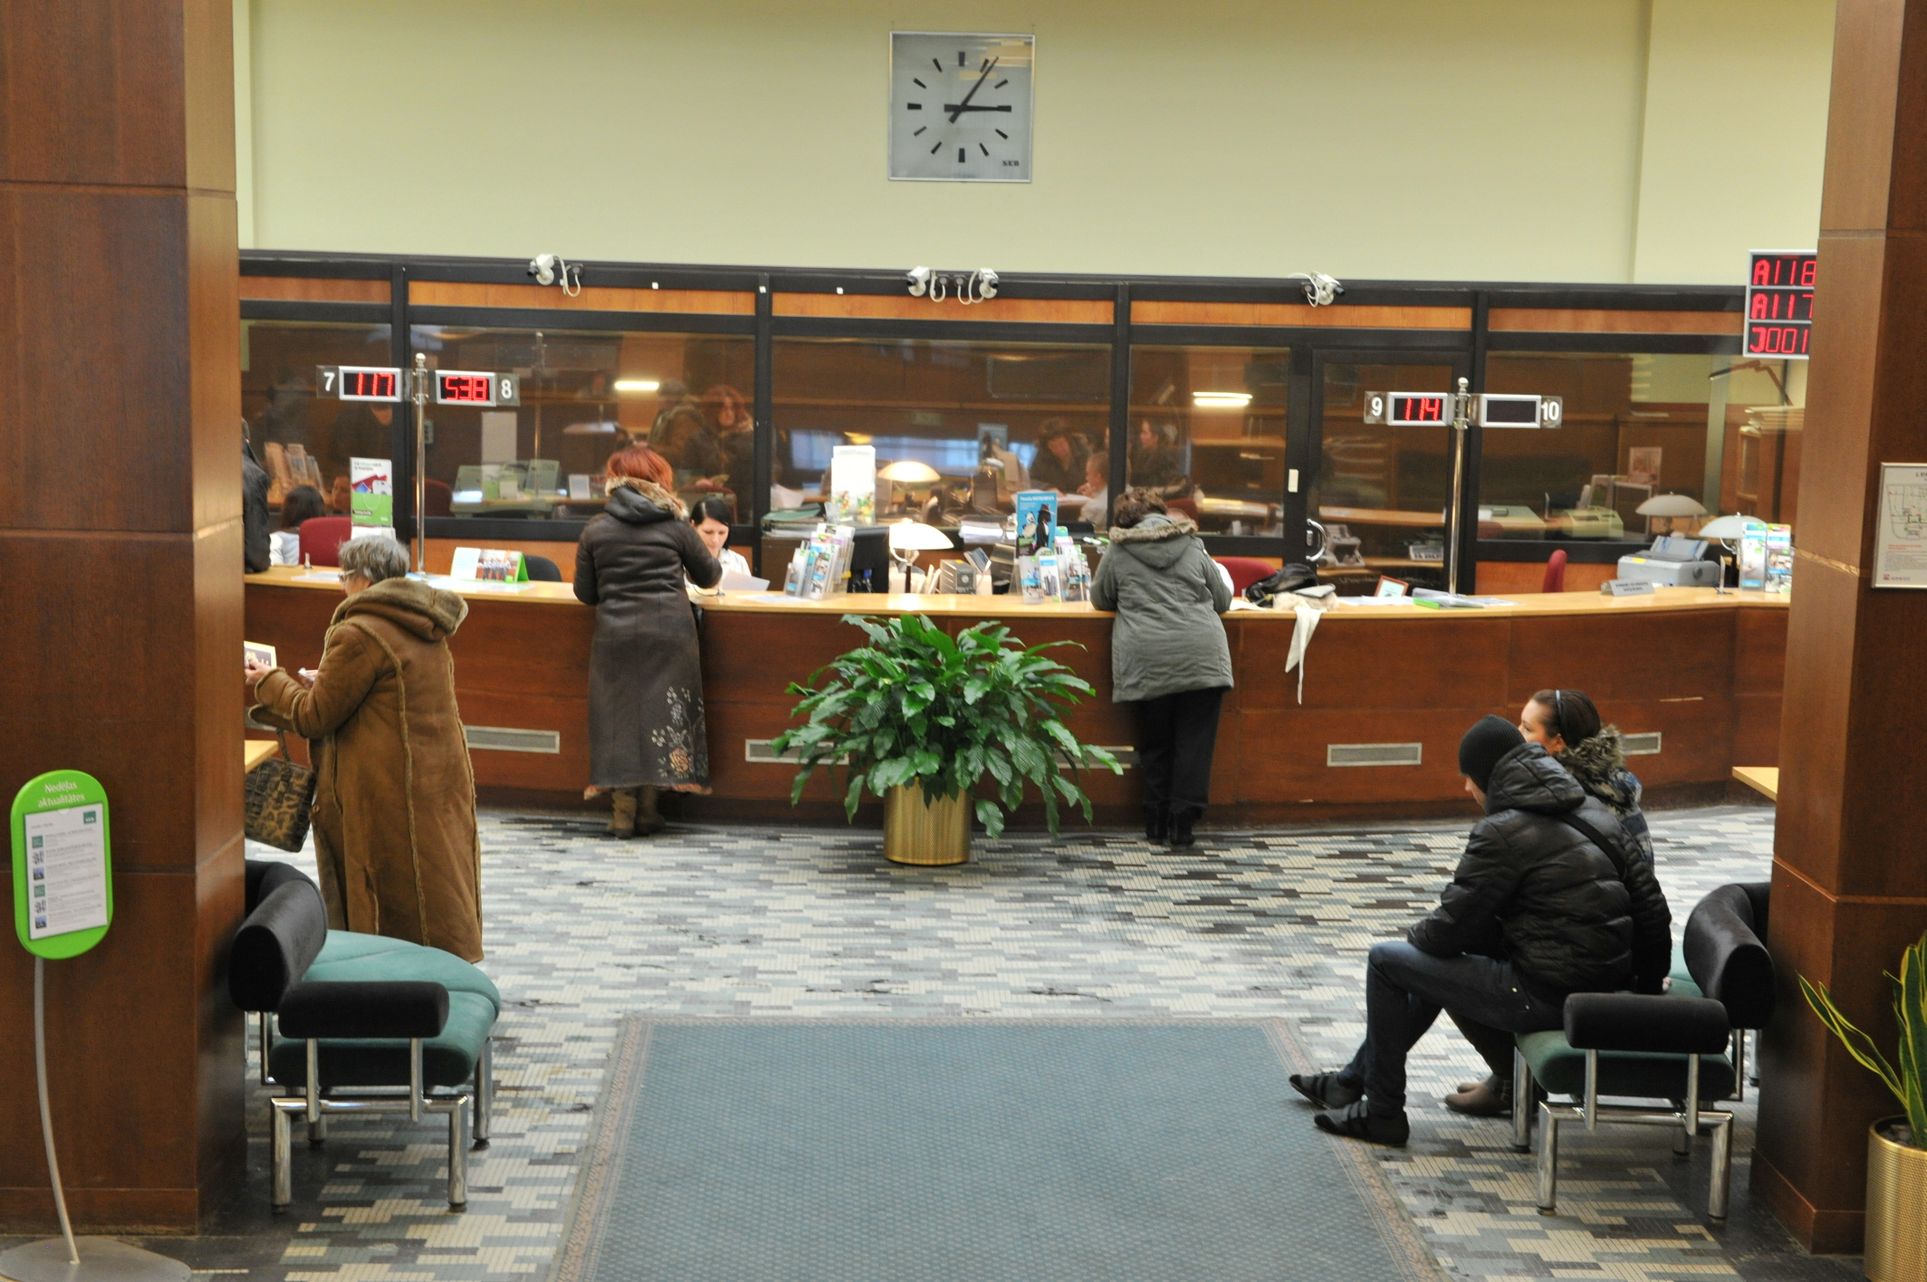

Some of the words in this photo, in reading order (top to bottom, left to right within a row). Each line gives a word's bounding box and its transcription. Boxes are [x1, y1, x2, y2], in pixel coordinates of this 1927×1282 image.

[1752, 259, 1817, 286] A118
[1750, 293, 1814, 320] A117
[323, 372, 335, 392] 7
[356, 372, 395, 397] 117
[445, 375, 489, 401] 538
[501, 379, 513, 399] 8
[1371, 397, 1383, 416] 9
[1405, 397, 1441, 421] 114
[1541, 401, 1560, 421] 10
